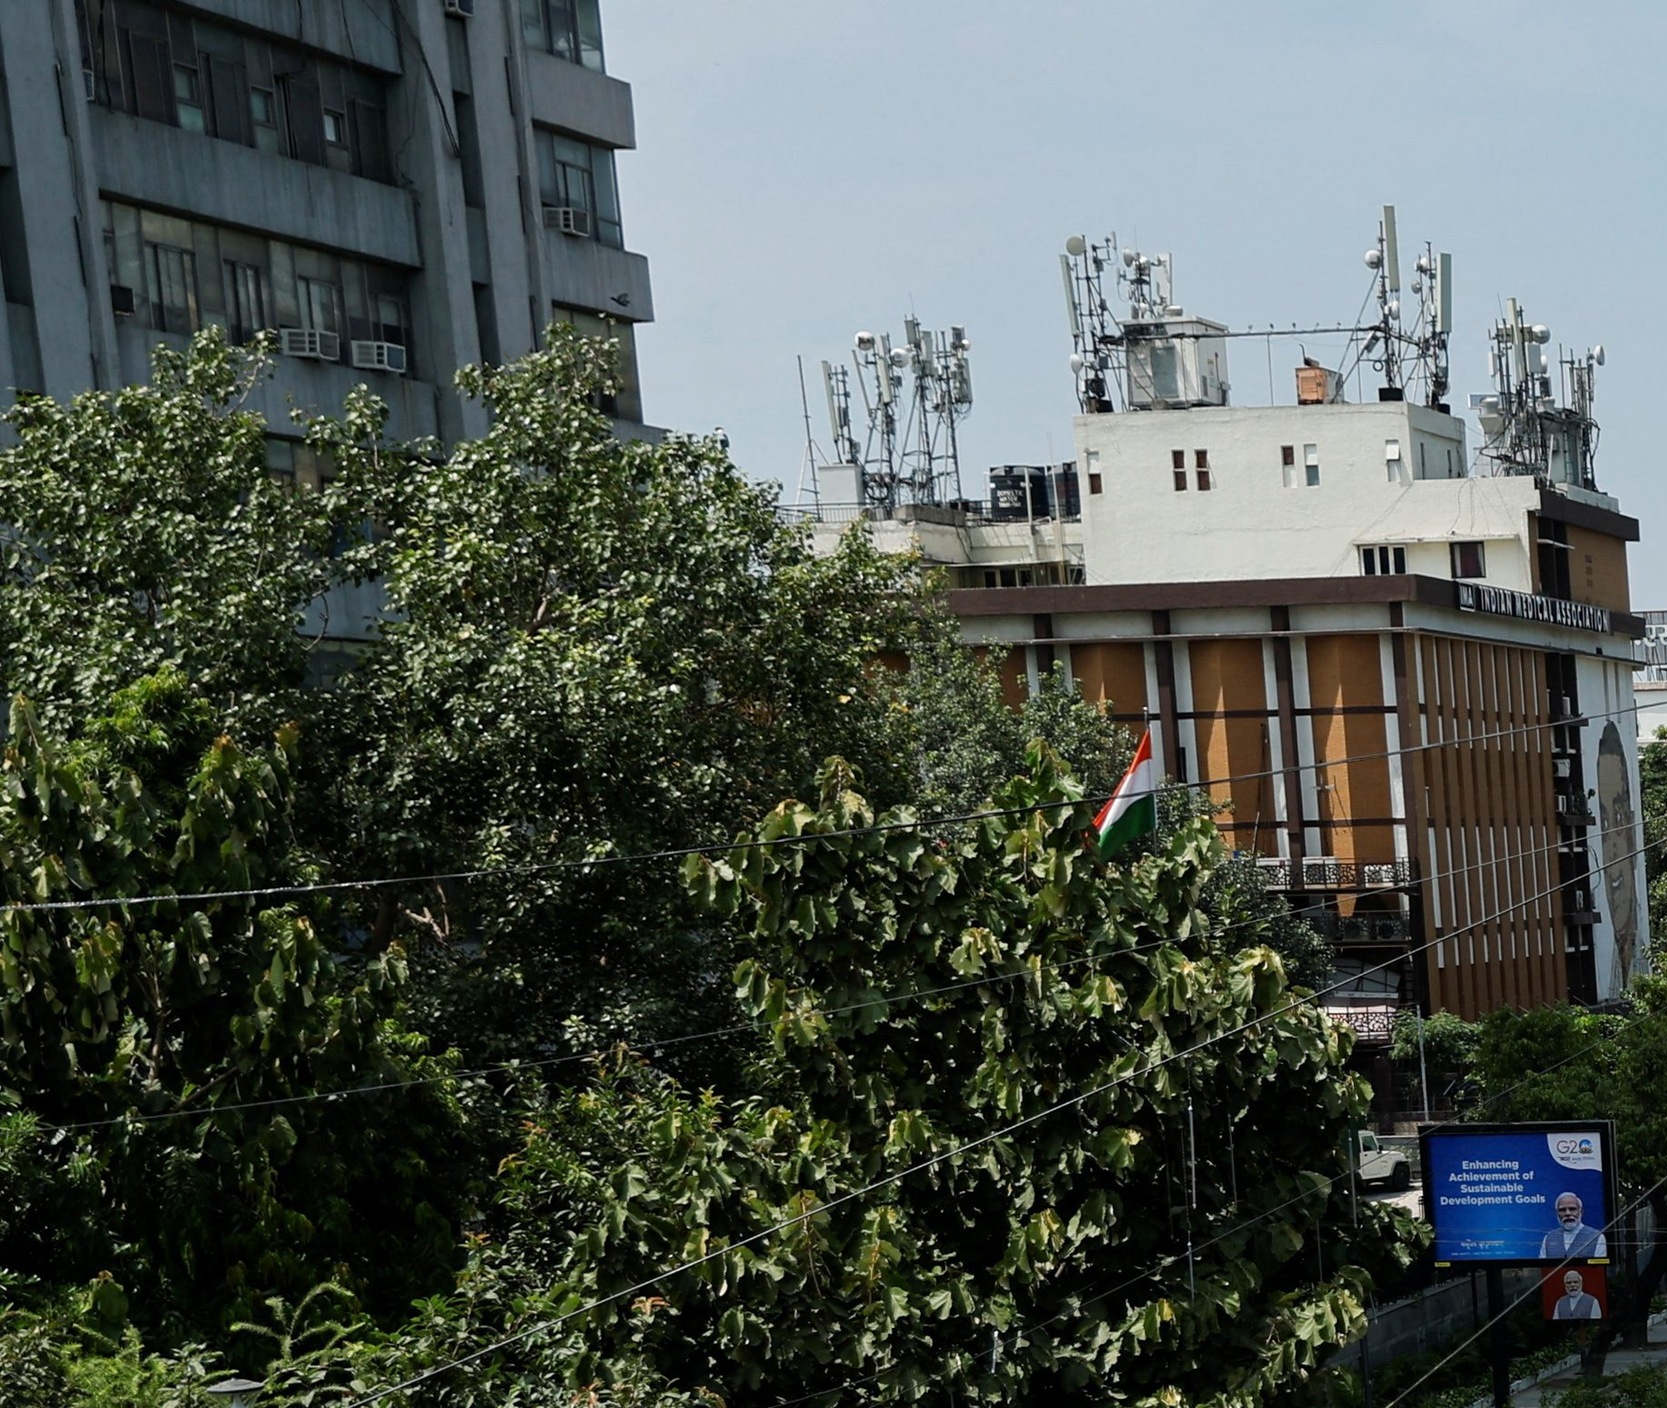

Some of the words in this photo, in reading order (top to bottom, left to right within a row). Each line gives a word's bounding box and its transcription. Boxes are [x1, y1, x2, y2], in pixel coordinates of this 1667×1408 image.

[1460, 584, 1474, 607] IMA
[1479, 585, 1512, 616] INDIAN
[1513, 591, 1554, 623] MEDICAL
[1556, 601, 1609, 632] ASSOCIATION
[1556, 1138, 1594, 1155] G20
[1462, 1159, 1519, 1171] Enhancing
[1449, 1171, 1520, 1182] Achievement
[1522, 1170, 1535, 1180] of
[1460, 1183, 1524, 1193] Sustainable
[1440, 1195, 1513, 1206] Development
[1515, 1194, 1546, 1204] Goals
